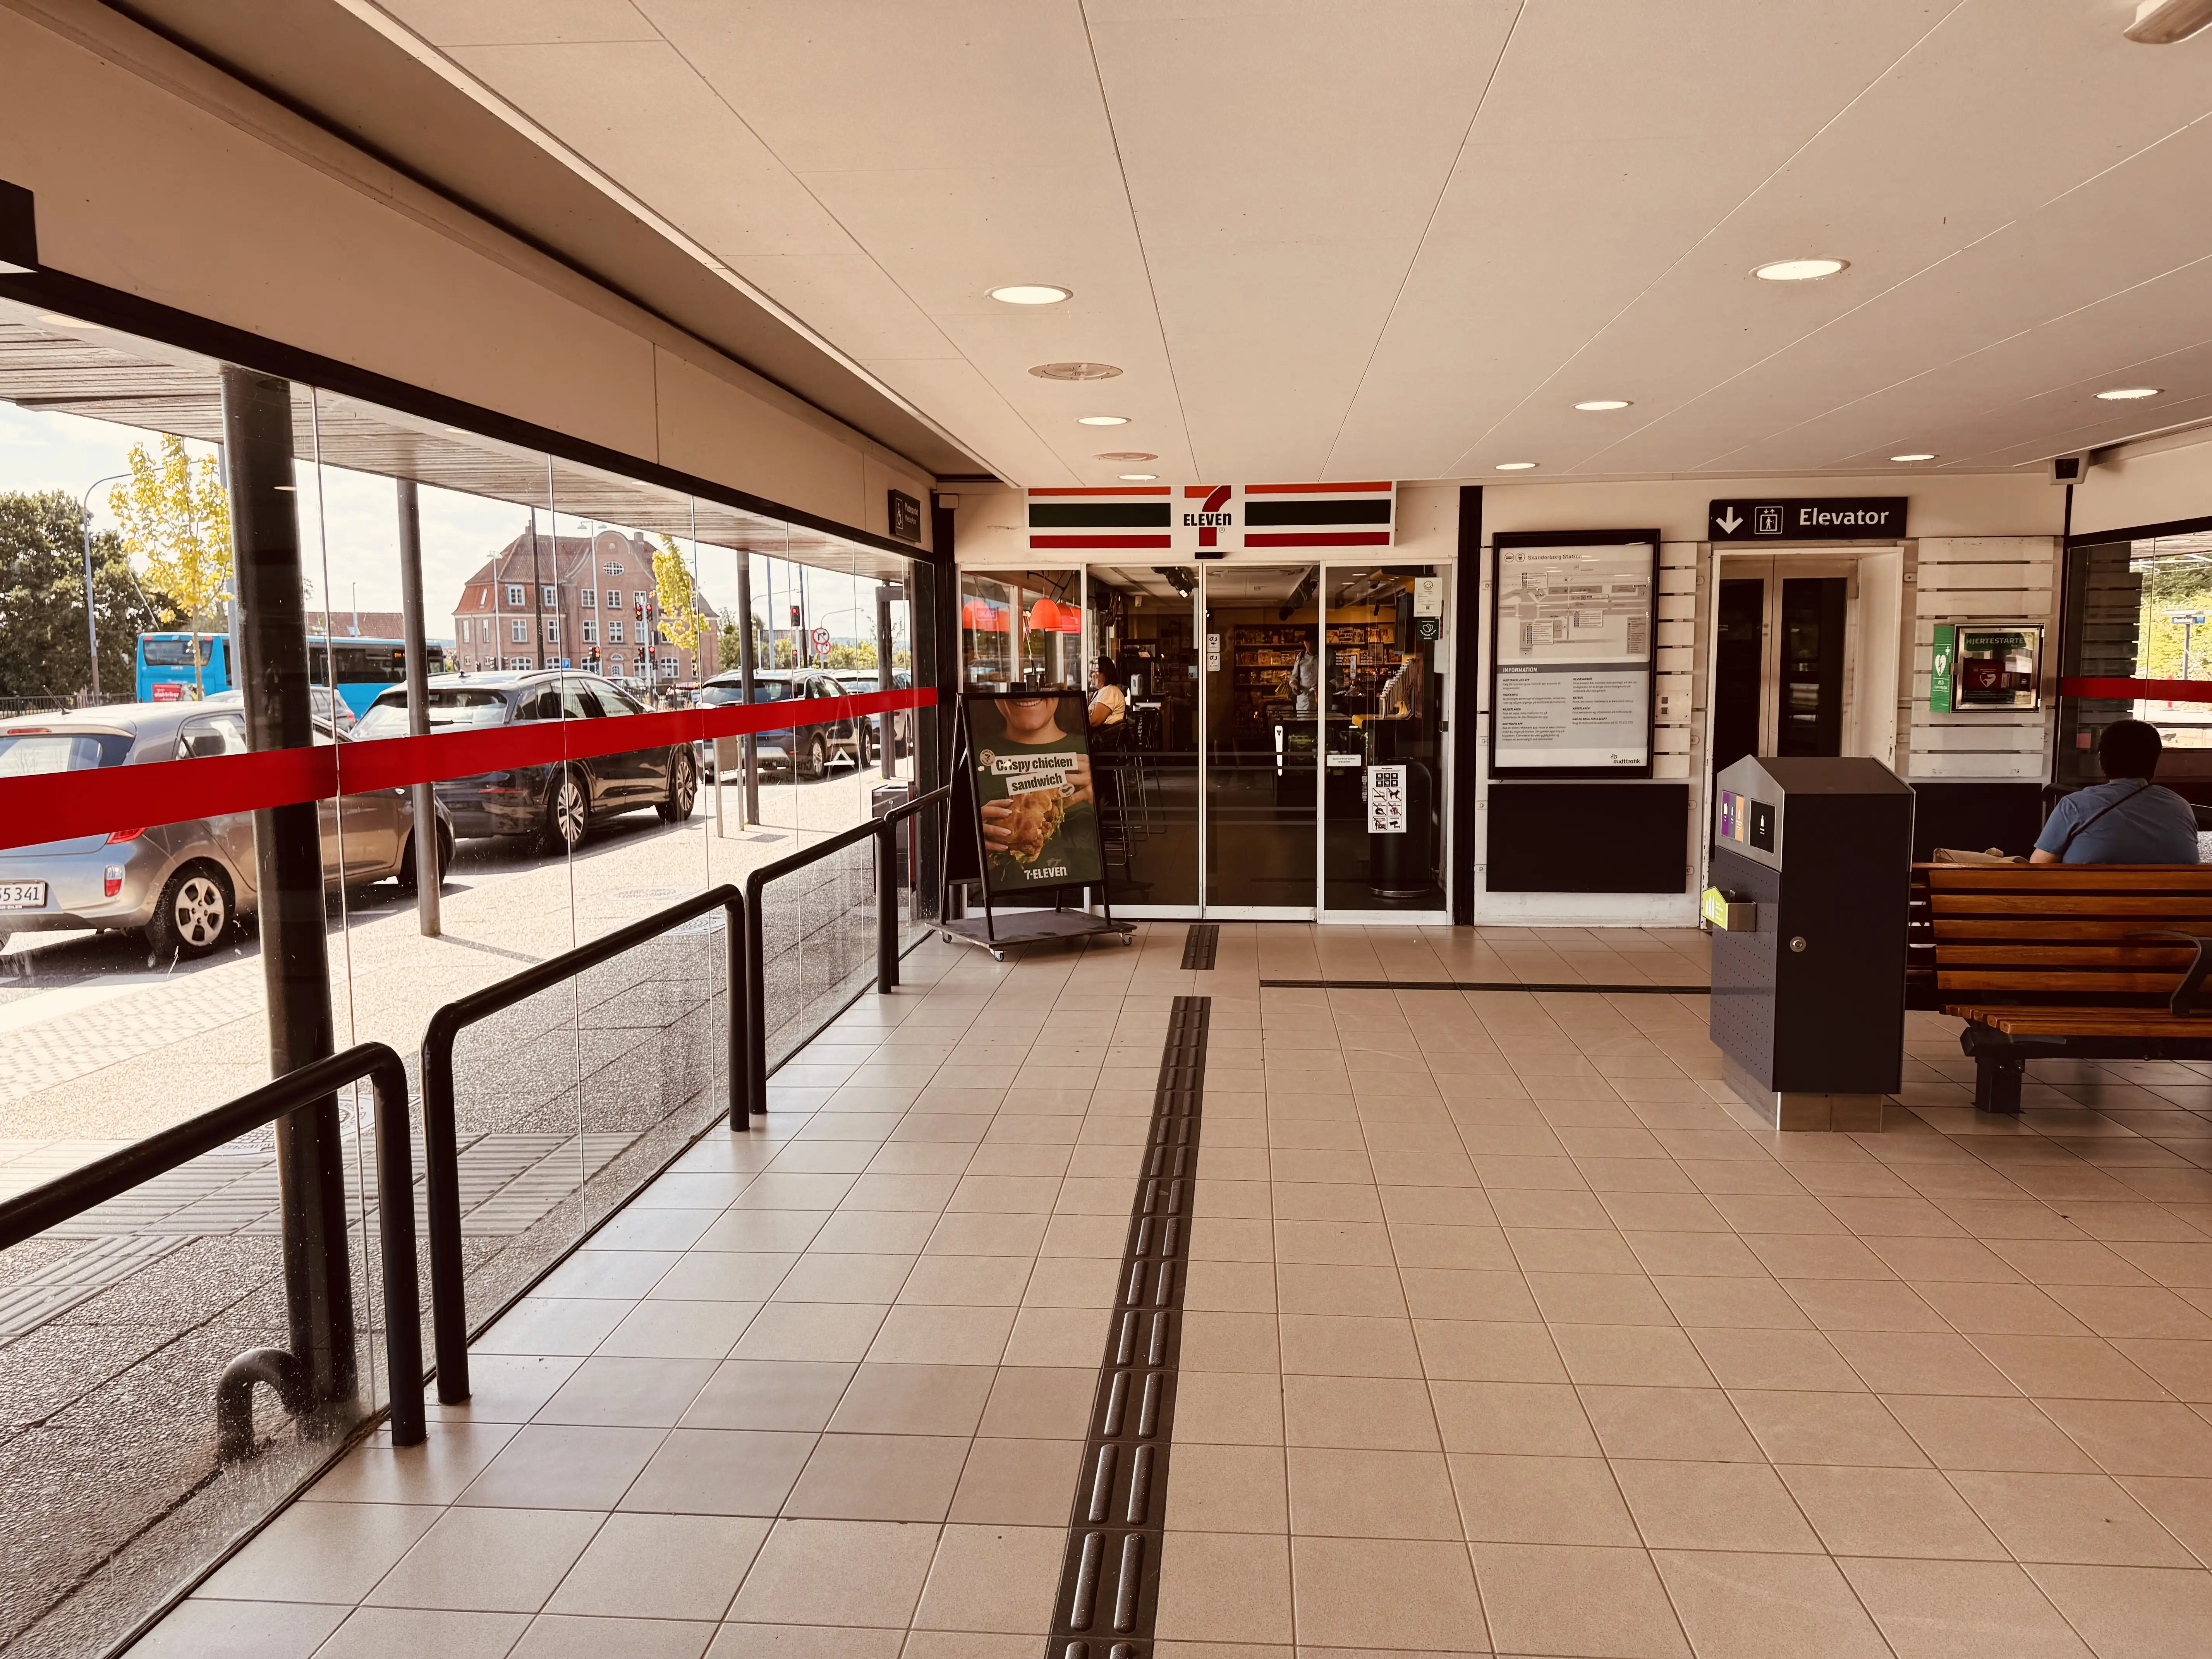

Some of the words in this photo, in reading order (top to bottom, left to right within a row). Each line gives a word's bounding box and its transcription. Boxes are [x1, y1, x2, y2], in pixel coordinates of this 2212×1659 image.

[1800, 508, 1889, 525] Elevator
[1032, 756, 1073, 769] chicken
[1012, 773, 1062, 791] sandwich
[14, 886, 39, 901] 341
